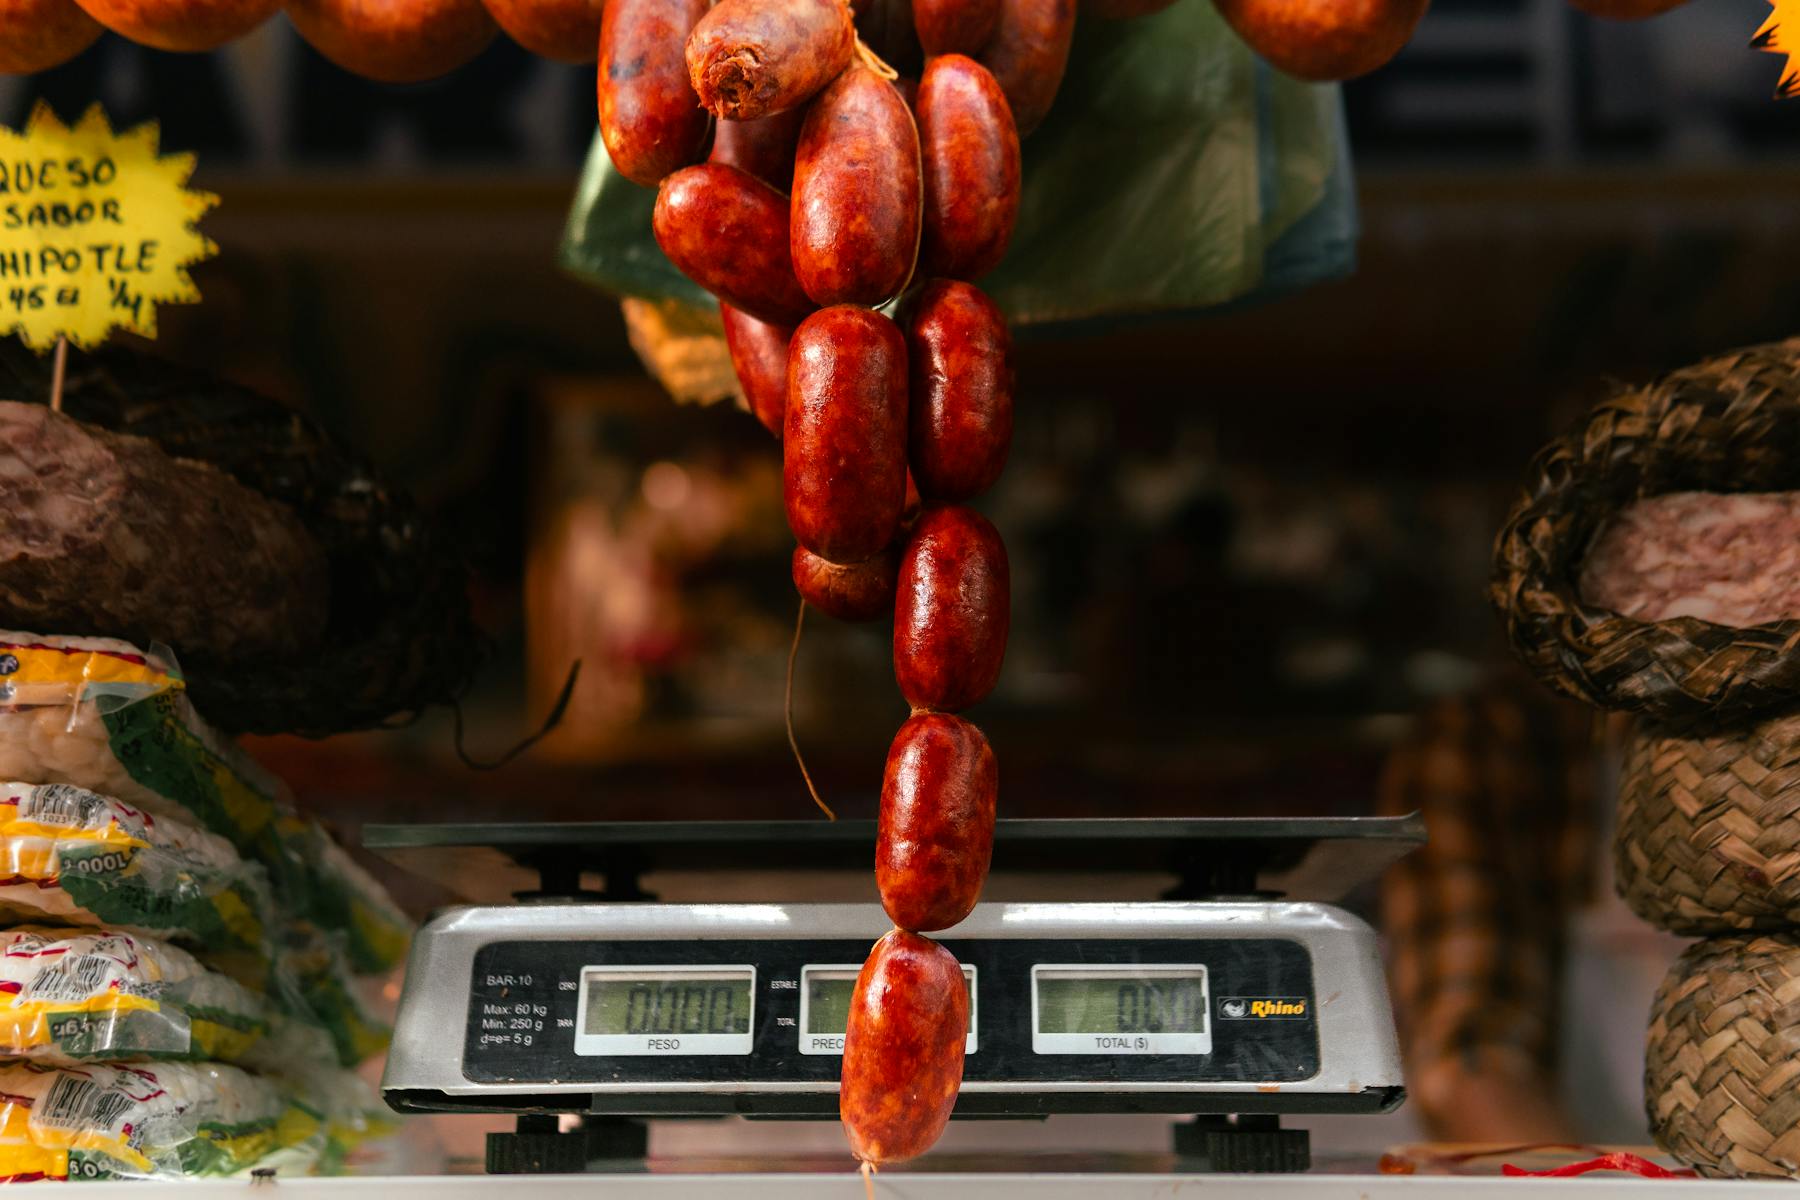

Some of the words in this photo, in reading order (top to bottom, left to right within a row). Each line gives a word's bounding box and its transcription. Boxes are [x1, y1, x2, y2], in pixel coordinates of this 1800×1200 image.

[5, 199, 122, 228] SABOR
[0, 240, 157, 277] HIPOTLE
[2, 285, 46, 312] 45
[486, 974, 532, 986] BAR-10
[771, 980, 797, 989] ESTABLE
[514, 1003, 531, 1015] 60
[532, 1003, 548, 1017] kg
[1251, 1000, 1305, 1018] Rhino
[509, 1018, 533, 1029] 250
[534, 1020, 544, 1031] g
[513, 1033, 522, 1043] 5
[523, 1034, 533, 1046] g
[647, 1038, 681, 1050] PESO
[811, 1038, 844, 1049] PREC
[1095, 1037, 1132, 1049] TOTAL
[1134, 1037, 1150, 1050] ($)
